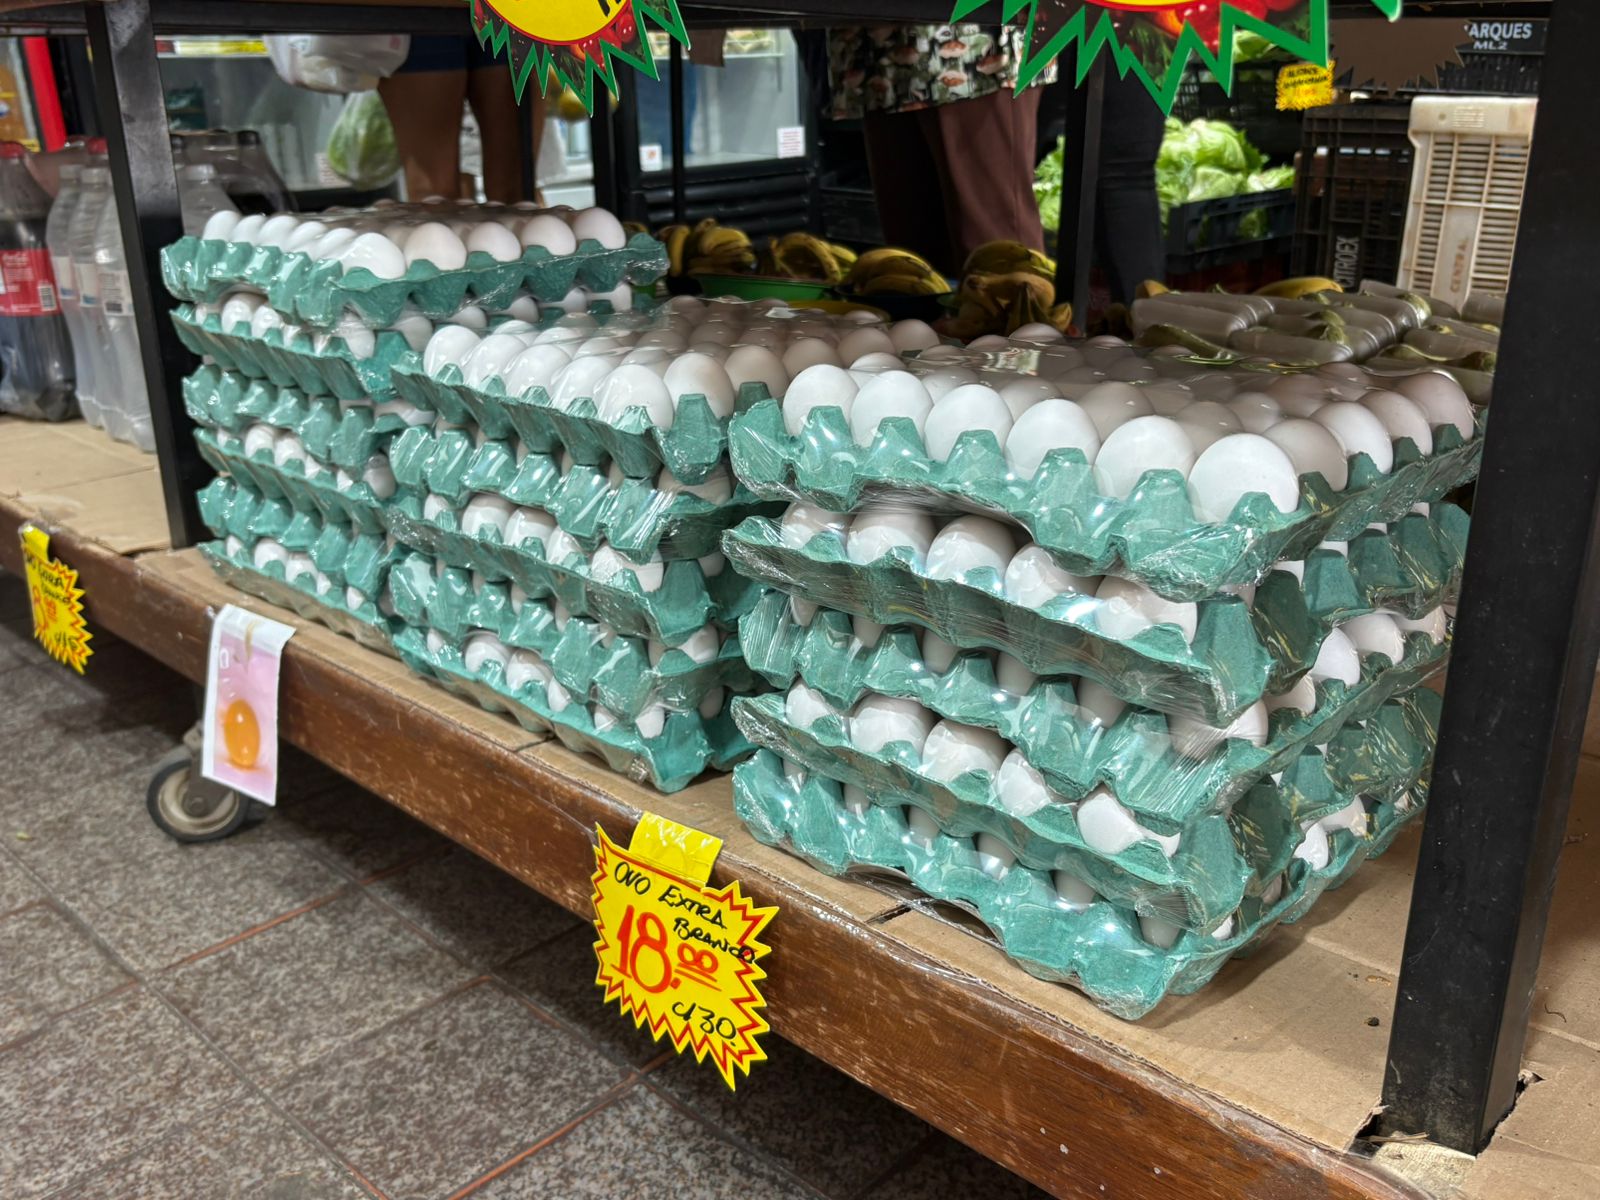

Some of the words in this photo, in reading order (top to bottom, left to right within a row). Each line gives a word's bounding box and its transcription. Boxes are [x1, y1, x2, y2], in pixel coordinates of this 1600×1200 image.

[1464, 22, 1533, 41] ARQUES
[613, 860, 651, 895] OVO
[658, 884, 728, 930] EXTRA
[673, 917, 756, 964] BRANCO
